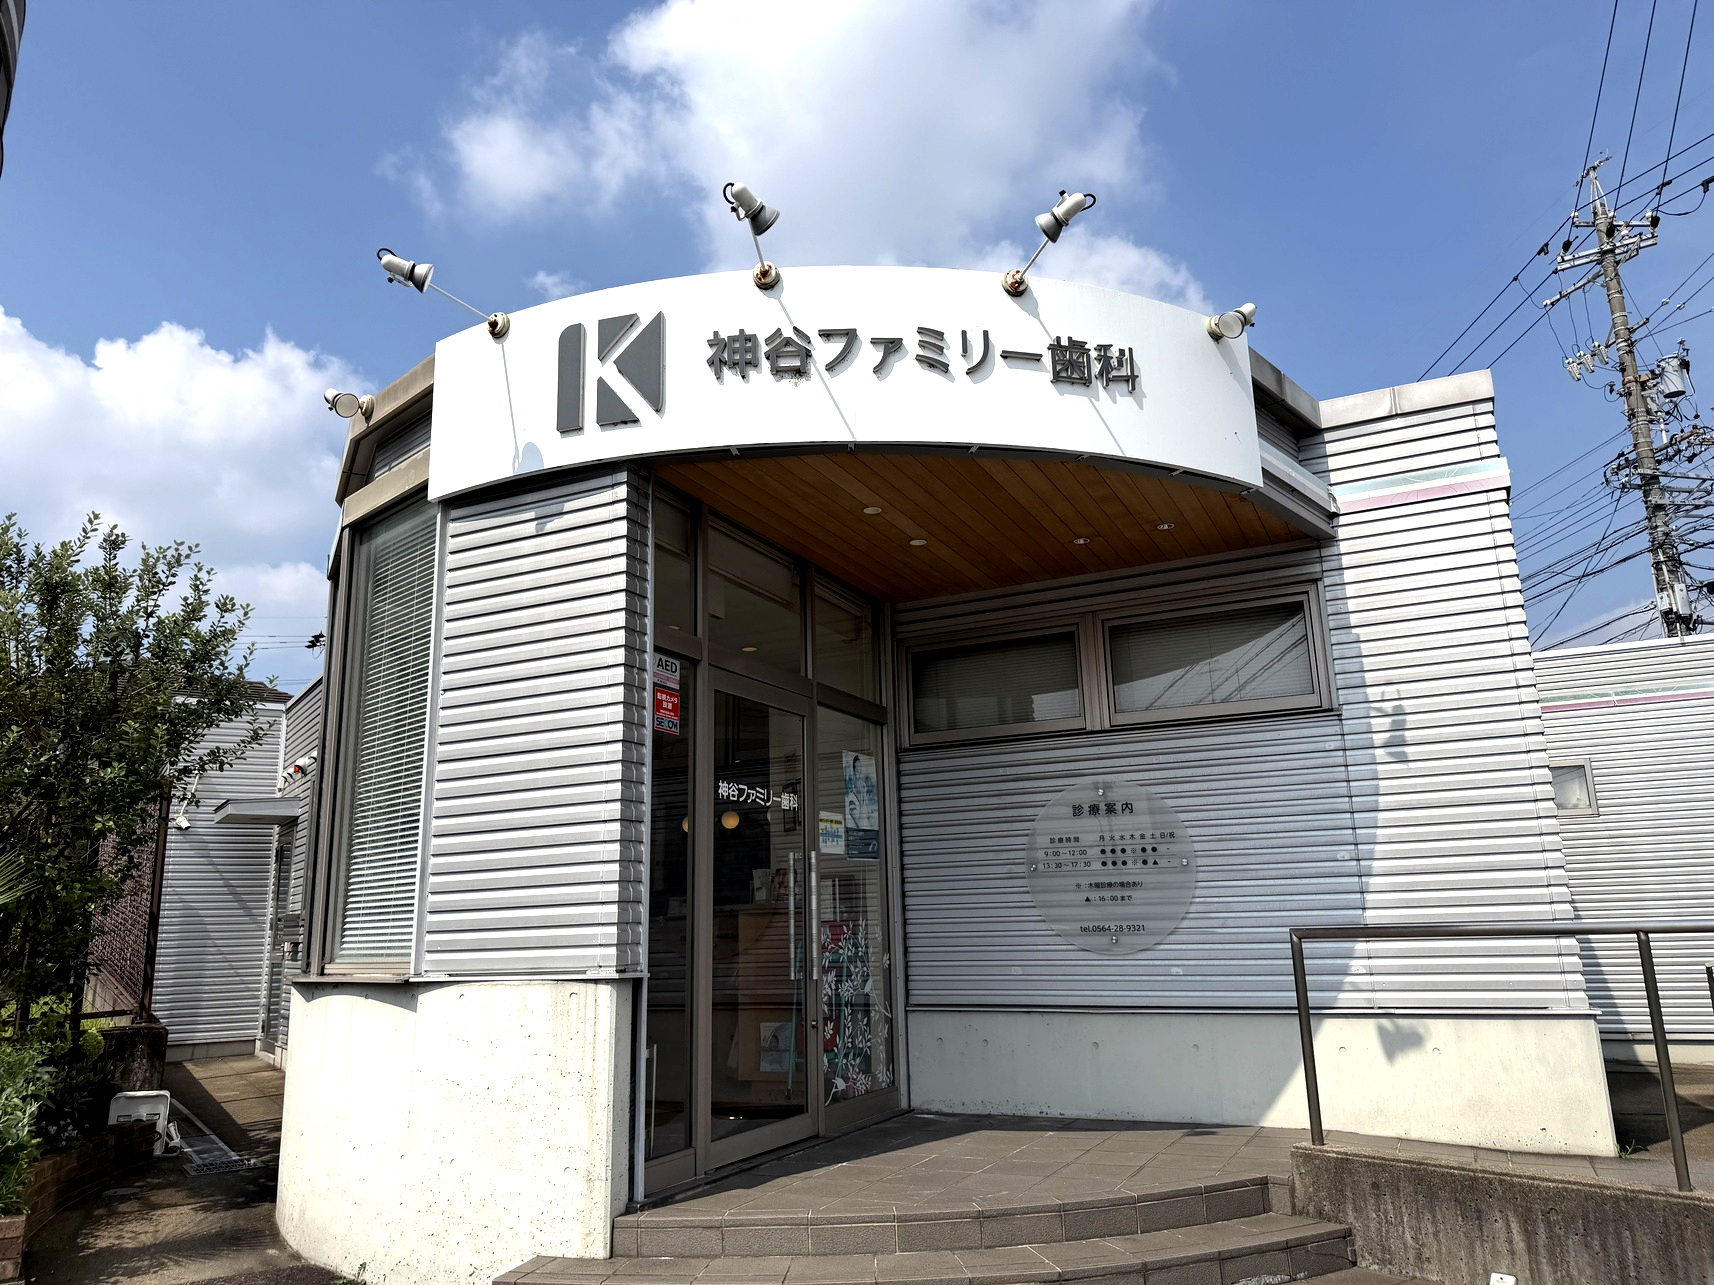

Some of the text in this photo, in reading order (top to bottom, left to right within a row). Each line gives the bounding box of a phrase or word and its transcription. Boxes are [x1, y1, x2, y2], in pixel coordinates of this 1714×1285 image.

[706, 327, 1140, 394] 神谷ファミリー歯科
[656, 657, 678, 674] AED
[655, 716, 678, 731] SECOM
[718, 780, 798, 811] 神谷ファミリー歯科
[1072, 801, 1134, 817] 診療案内
[1079, 924, 1145, 933] tel.0564-28-9321
